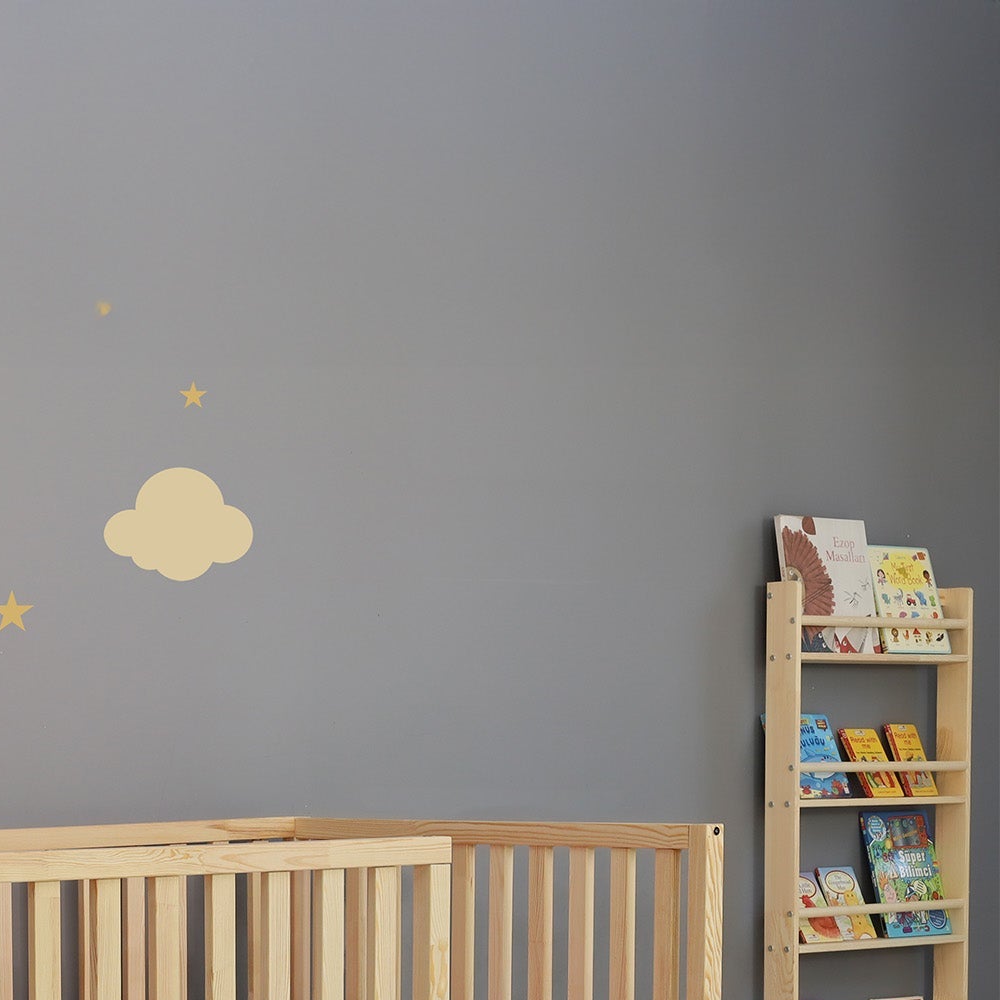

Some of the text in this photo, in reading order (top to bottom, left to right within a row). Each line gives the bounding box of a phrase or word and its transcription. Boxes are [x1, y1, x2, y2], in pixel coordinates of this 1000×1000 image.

[833, 536, 855, 551] Ezop
[898, 850, 926, 865] Süper
[899, 864, 932, 878] Bilimci
